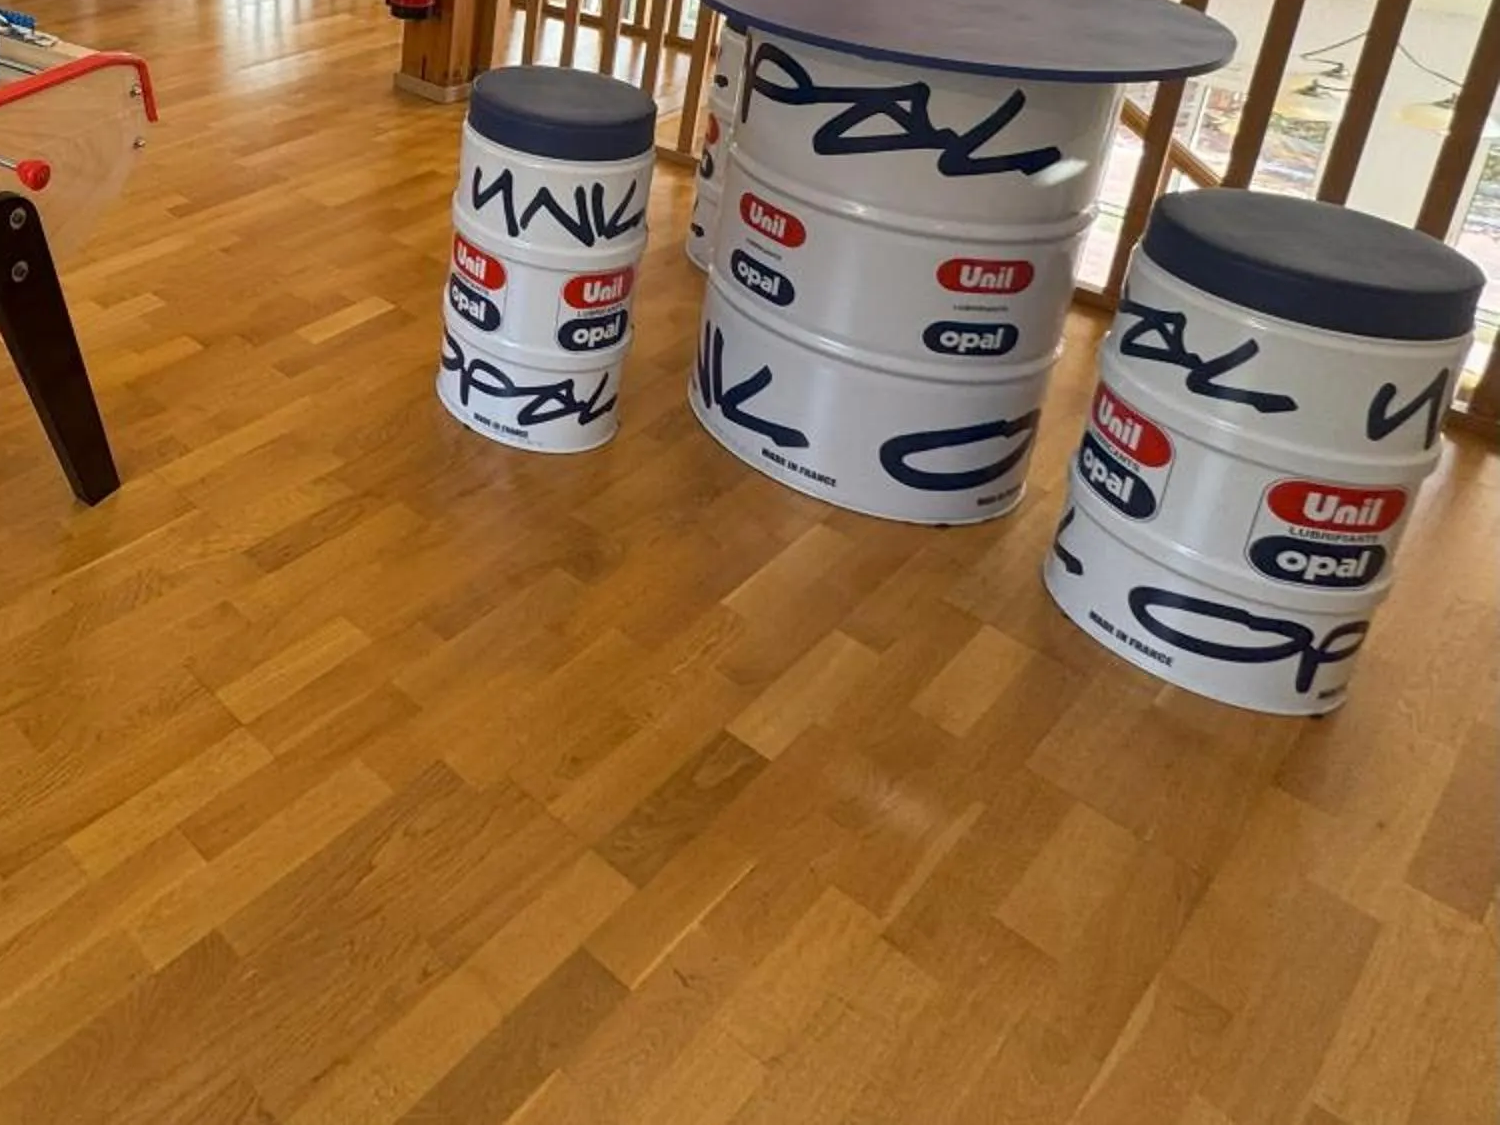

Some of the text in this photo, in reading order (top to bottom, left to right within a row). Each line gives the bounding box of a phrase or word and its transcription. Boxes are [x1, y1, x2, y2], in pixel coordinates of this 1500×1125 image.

[750, 201, 787, 239] Unil
[457, 240, 487, 281] Unil
[737, 260, 781, 296] opal
[960, 264, 1015, 289] Unil
[452, 284, 487, 322] opal
[583, 274, 624, 304] Unil
[572, 314, 621, 348] opal
[939, 327, 1005, 353] opal
[1098, 394, 1144, 452] Unil
[761, 447, 837, 487] MADE IN FRANCE
[1083, 446, 1135, 503] opal
[1303, 491, 1385, 526] Unil
[1275, 549, 1372, 581] opal
[1089, 609, 1174, 667] MADE IN FRANCE
